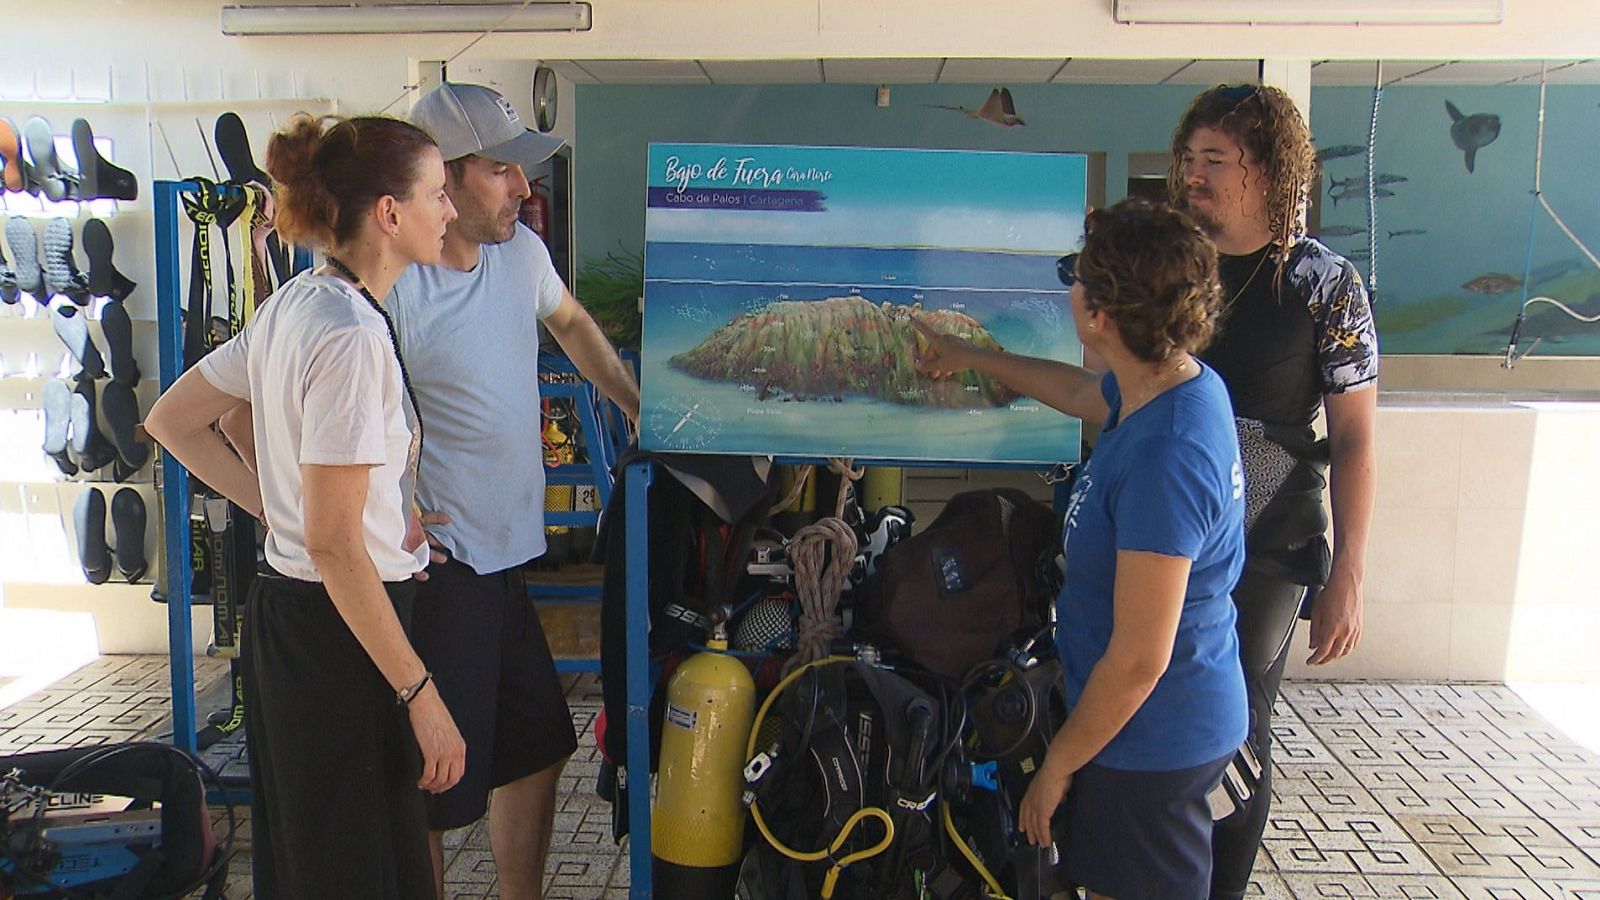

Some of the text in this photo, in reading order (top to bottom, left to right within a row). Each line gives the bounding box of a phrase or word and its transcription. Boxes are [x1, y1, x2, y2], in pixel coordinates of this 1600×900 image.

[665, 156, 702, 194] Bajo
[706, 156, 728, 181] de
[732, 157, 783, 188] Fuera
[786, 166, 805, 182] Cara
[665, 192, 693, 203] Cabo
[696, 193, 710, 203] de
[713, 193, 740, 205] Palos
